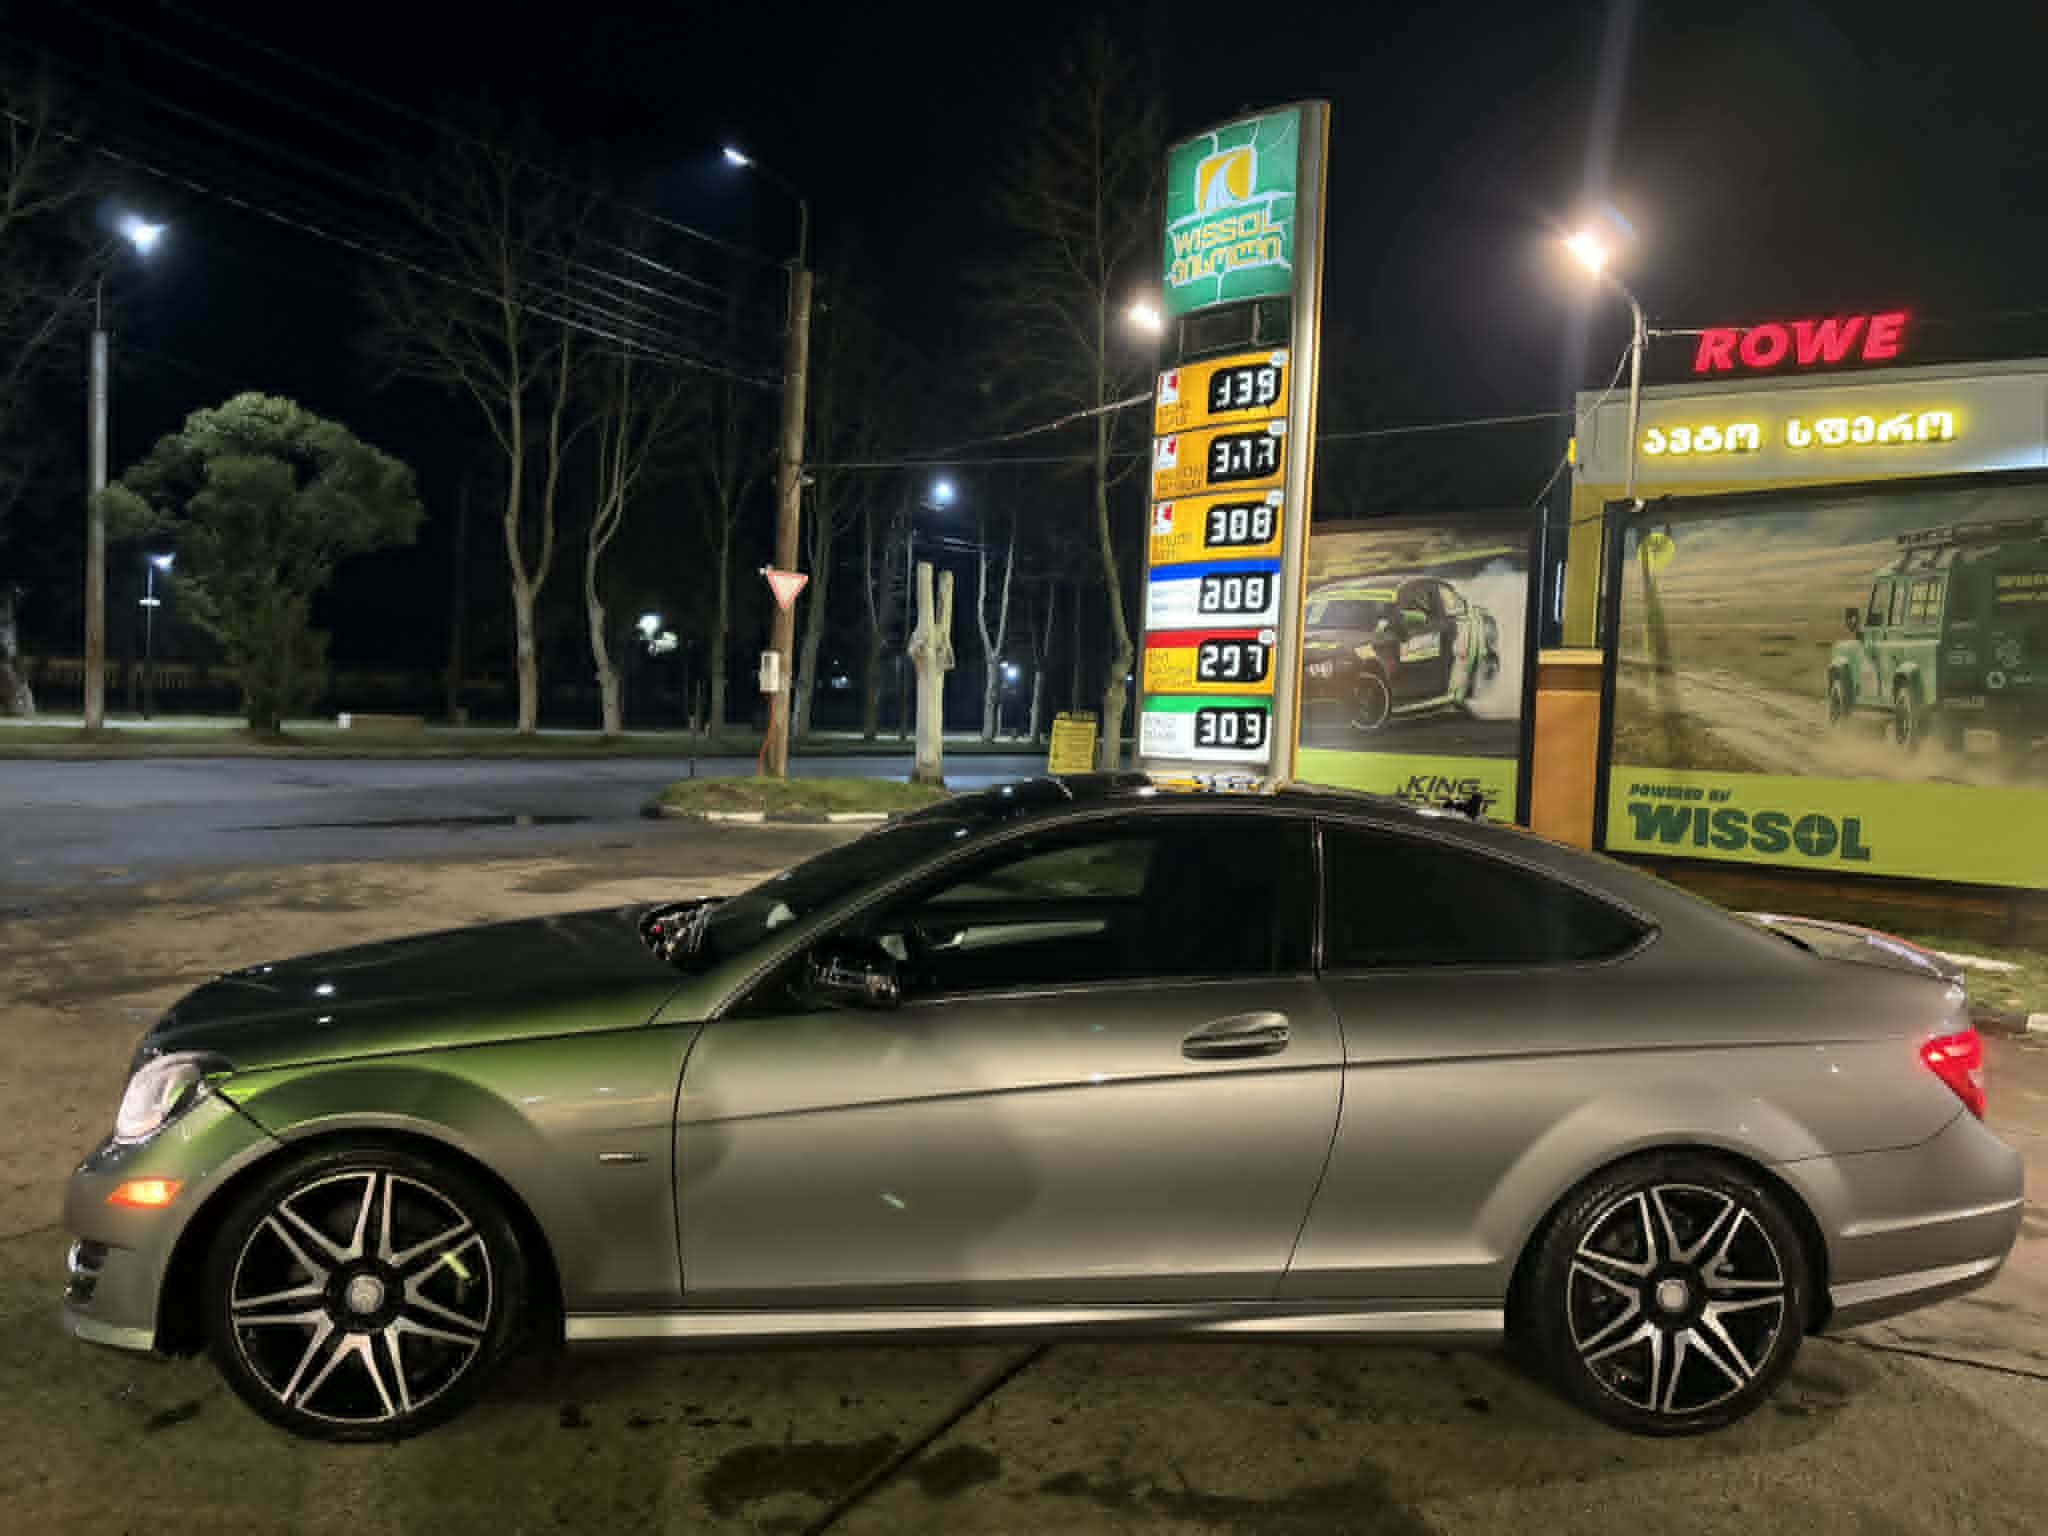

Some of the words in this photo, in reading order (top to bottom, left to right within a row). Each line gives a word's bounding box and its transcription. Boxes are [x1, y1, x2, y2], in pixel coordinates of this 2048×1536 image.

[1175, 209, 1281, 256] WISSOL
[1693, 312, 1906, 372] ROWE
[1643, 422, 1760, 455] ავტო
[1785, 410, 1955, 447] სფერო
[1200, 712, 1261, 744] 309
[1408, 775, 1480, 794] KING
[1627, 802, 1872, 861] WISSOL
